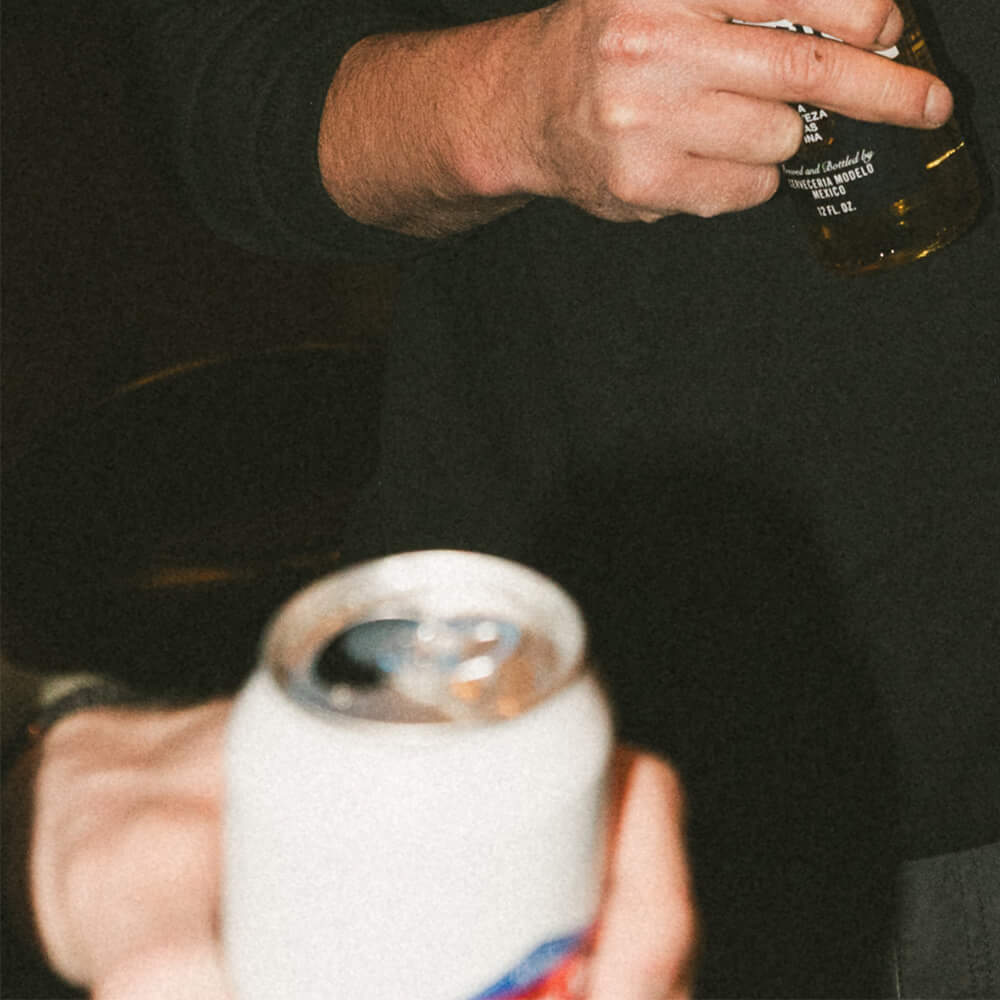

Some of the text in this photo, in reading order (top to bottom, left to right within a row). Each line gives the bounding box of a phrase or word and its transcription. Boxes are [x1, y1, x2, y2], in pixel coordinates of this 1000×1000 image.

[802, 109, 828, 122] EZA
[804, 122, 819, 133] AS
[803, 132, 824, 144] INA
[822, 151, 861, 173] Bottled
[860, 148, 875, 164] by
[833, 163, 875, 185] MODELO
[811, 185, 847, 200] MEXICO
[816, 206, 827, 217] 12
[840, 200, 857, 214] OZ.
